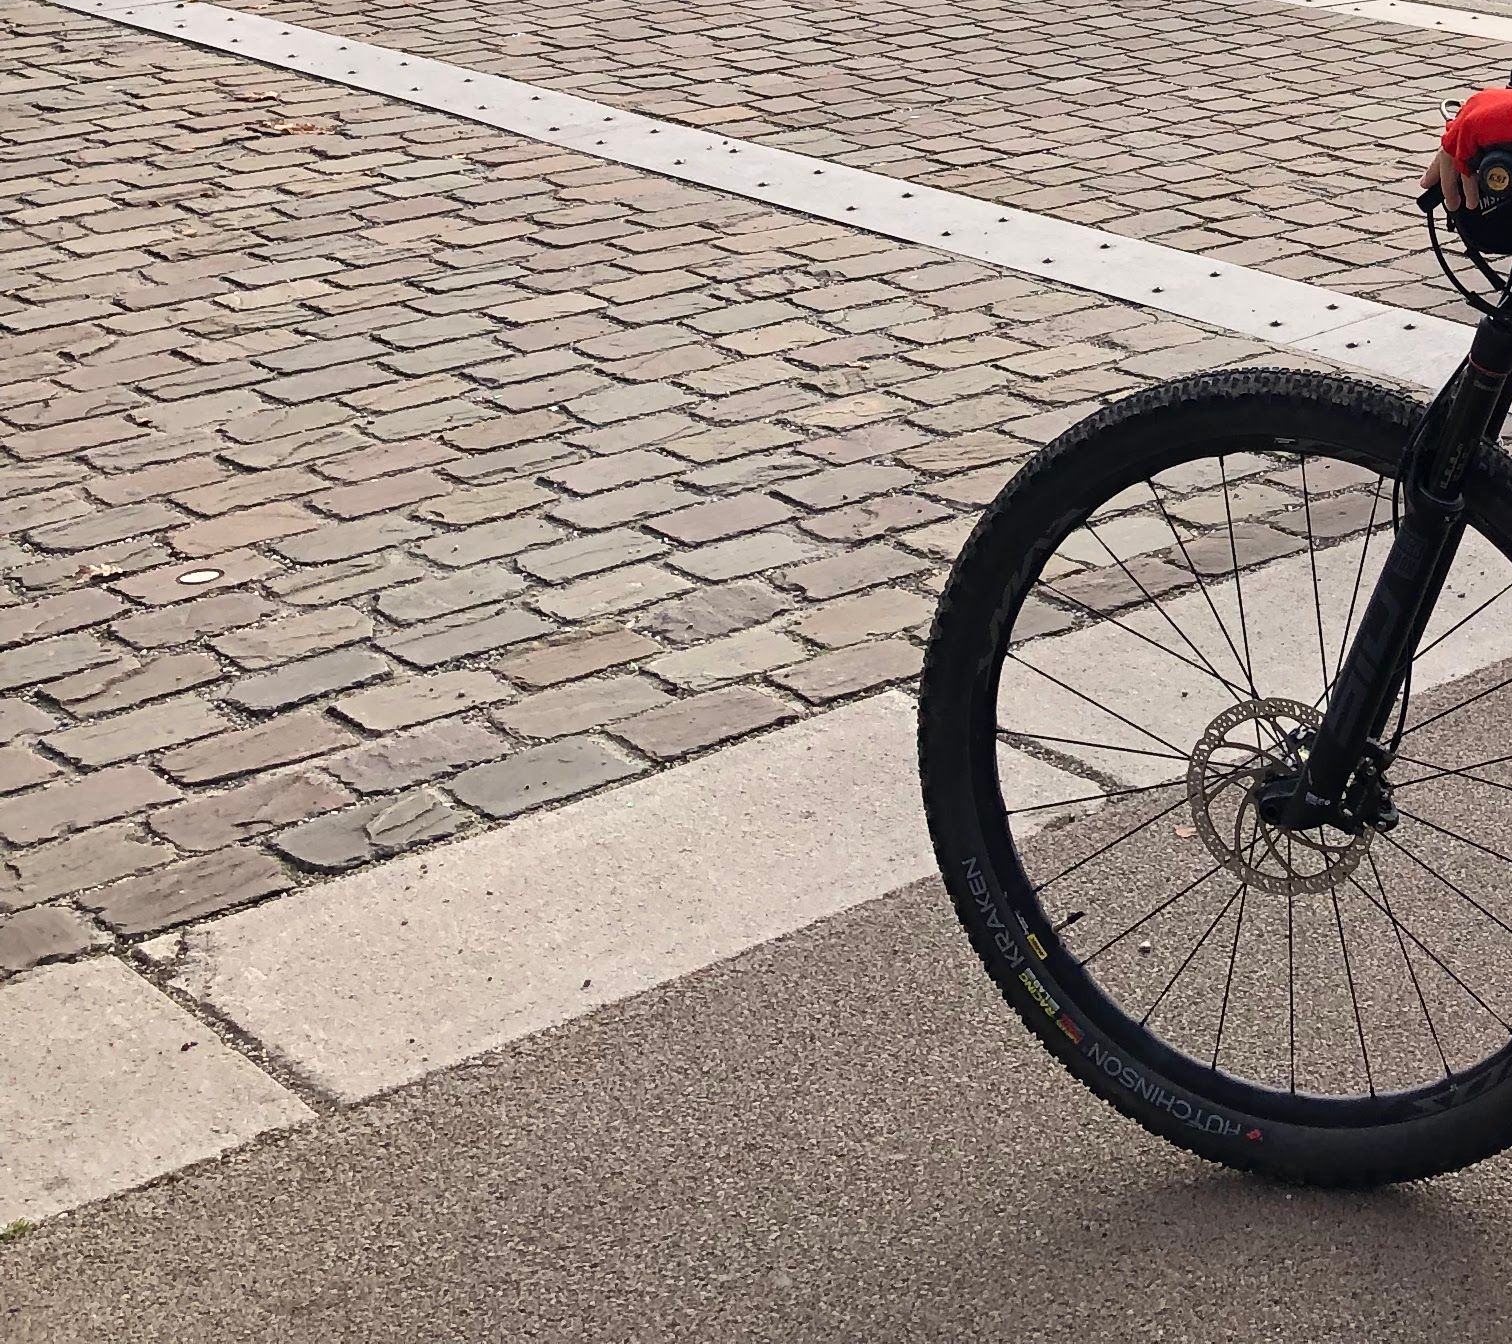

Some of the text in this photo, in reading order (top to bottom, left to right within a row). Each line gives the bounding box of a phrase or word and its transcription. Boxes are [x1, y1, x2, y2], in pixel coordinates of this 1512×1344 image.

[962, 857, 1025, 969] KRAKEN
[1019, 972, 1056, 1019] RACING
[1087, 1042, 1241, 1136] HUTCHINSON
